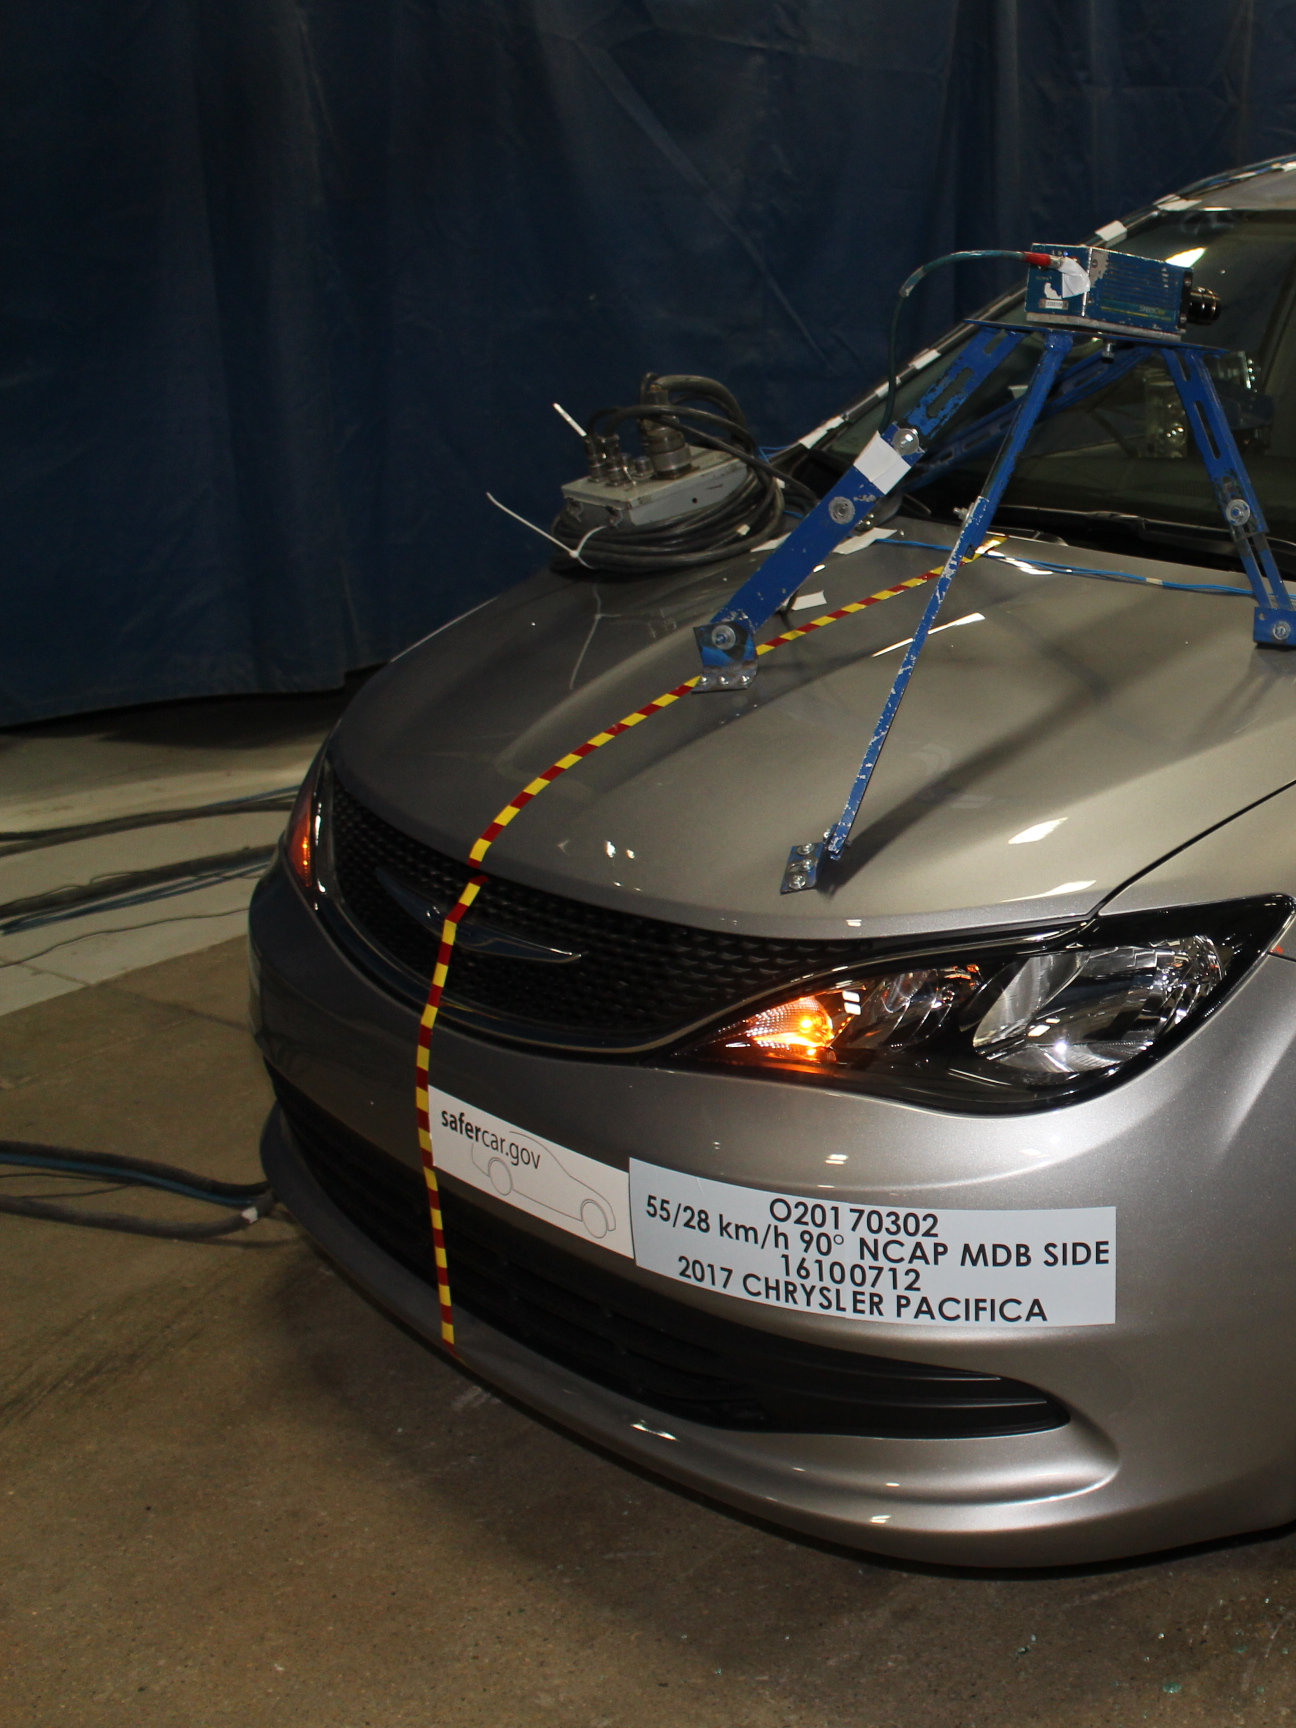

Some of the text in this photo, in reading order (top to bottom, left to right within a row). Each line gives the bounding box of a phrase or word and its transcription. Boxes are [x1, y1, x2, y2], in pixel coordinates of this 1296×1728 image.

[441, 1109, 541, 1169] safercar.gov
[646, 1194, 1109, 1267] 55/28 km/h 90° NCAP MDB SIDE
[678, 1255, 1048, 1323] 2017 CHRYSLER PACIFICA
[781, 1253, 921, 1292] 16100712
